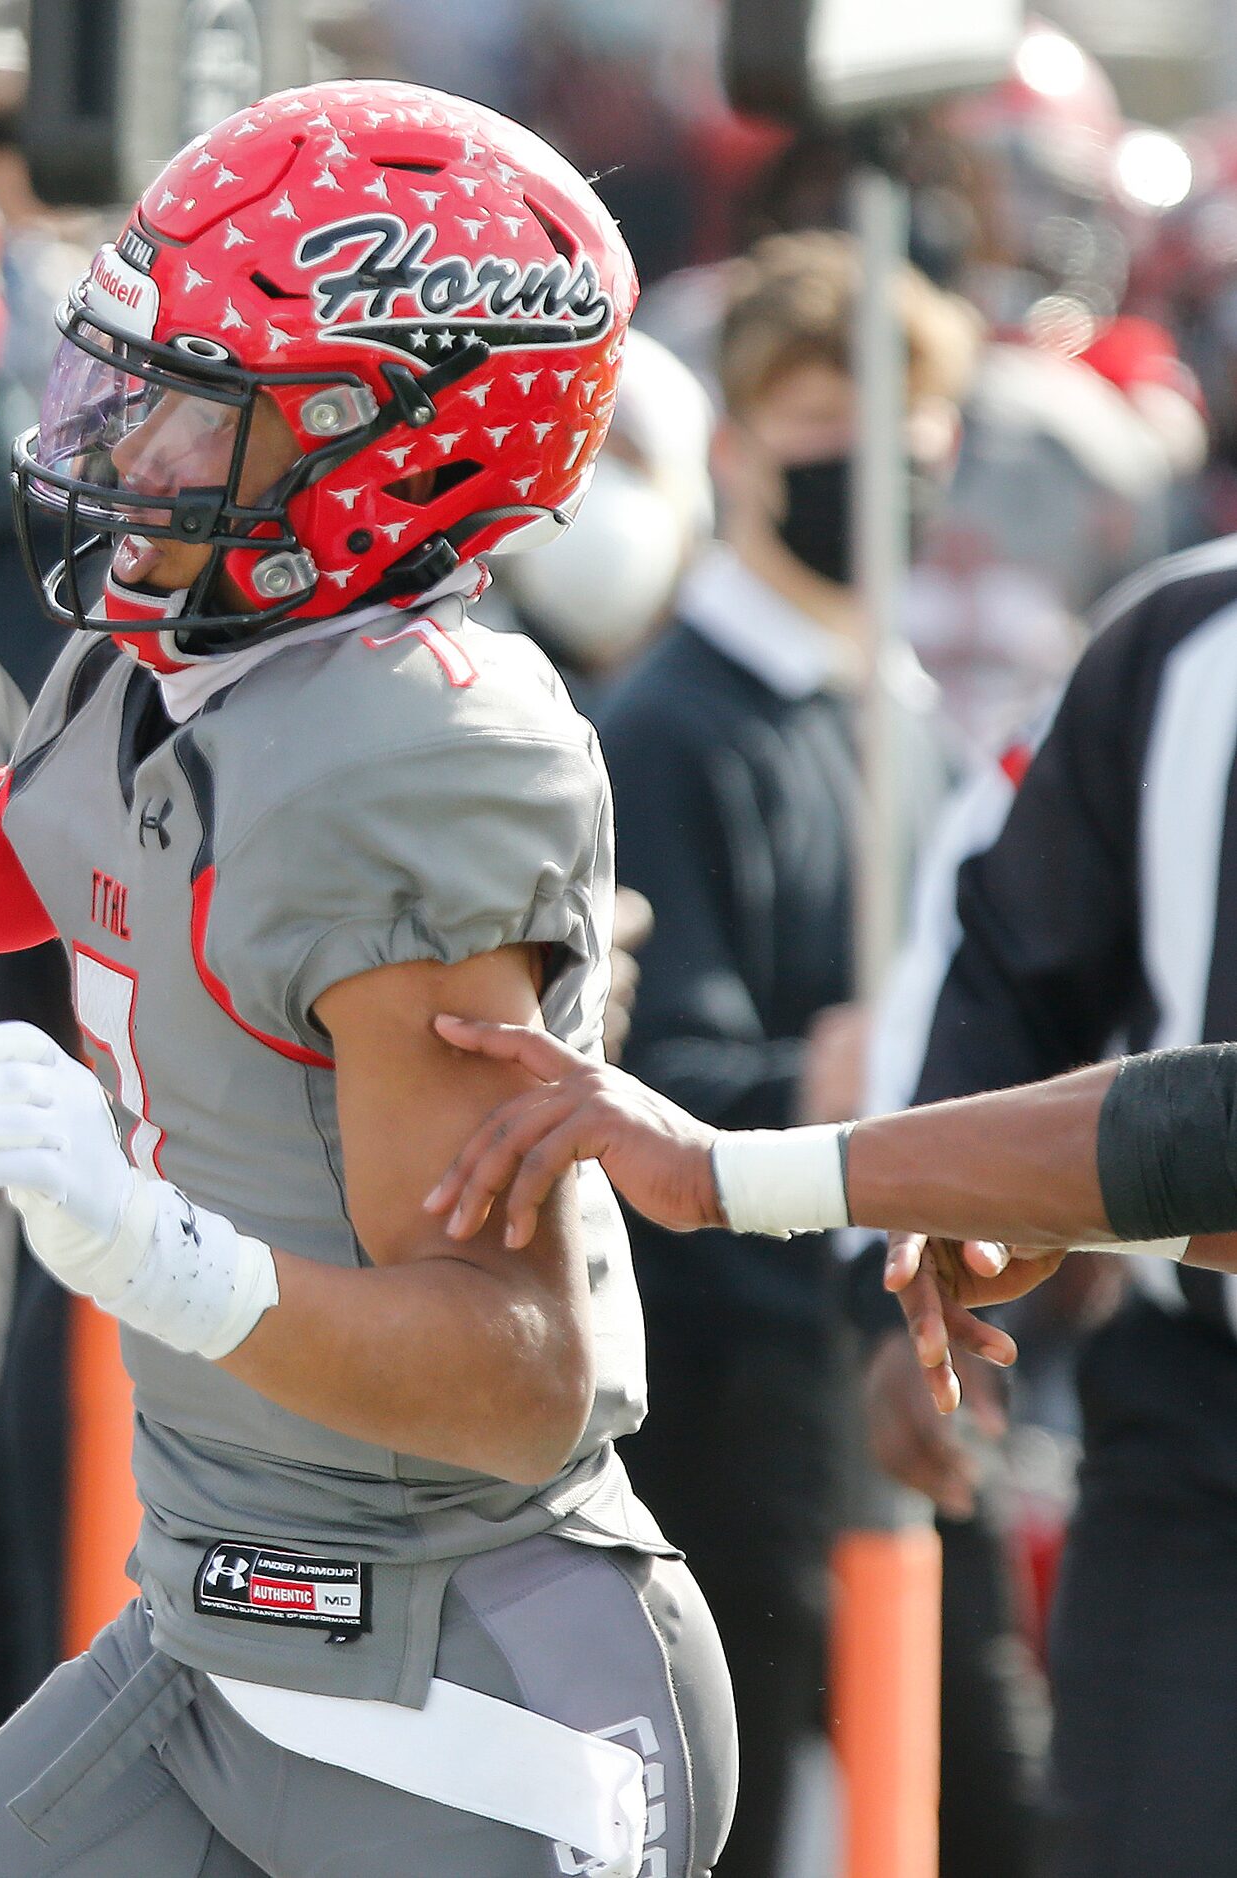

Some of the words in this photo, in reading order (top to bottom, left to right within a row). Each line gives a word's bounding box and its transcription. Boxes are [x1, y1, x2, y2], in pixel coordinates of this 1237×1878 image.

[123, 229, 151, 269] TTHL
[294, 212, 613, 324] Horns
[95, 259, 142, 309] Riddell
[360, 616, 479, 688] 7
[72, 939, 166, 1181] 7
[258, 1558, 295, 1573] UNDER
[296, 1566, 354, 1577] ARMOUR
[254, 1585, 312, 1604] AUTHENTIC
[324, 1595, 352, 1606] MD
